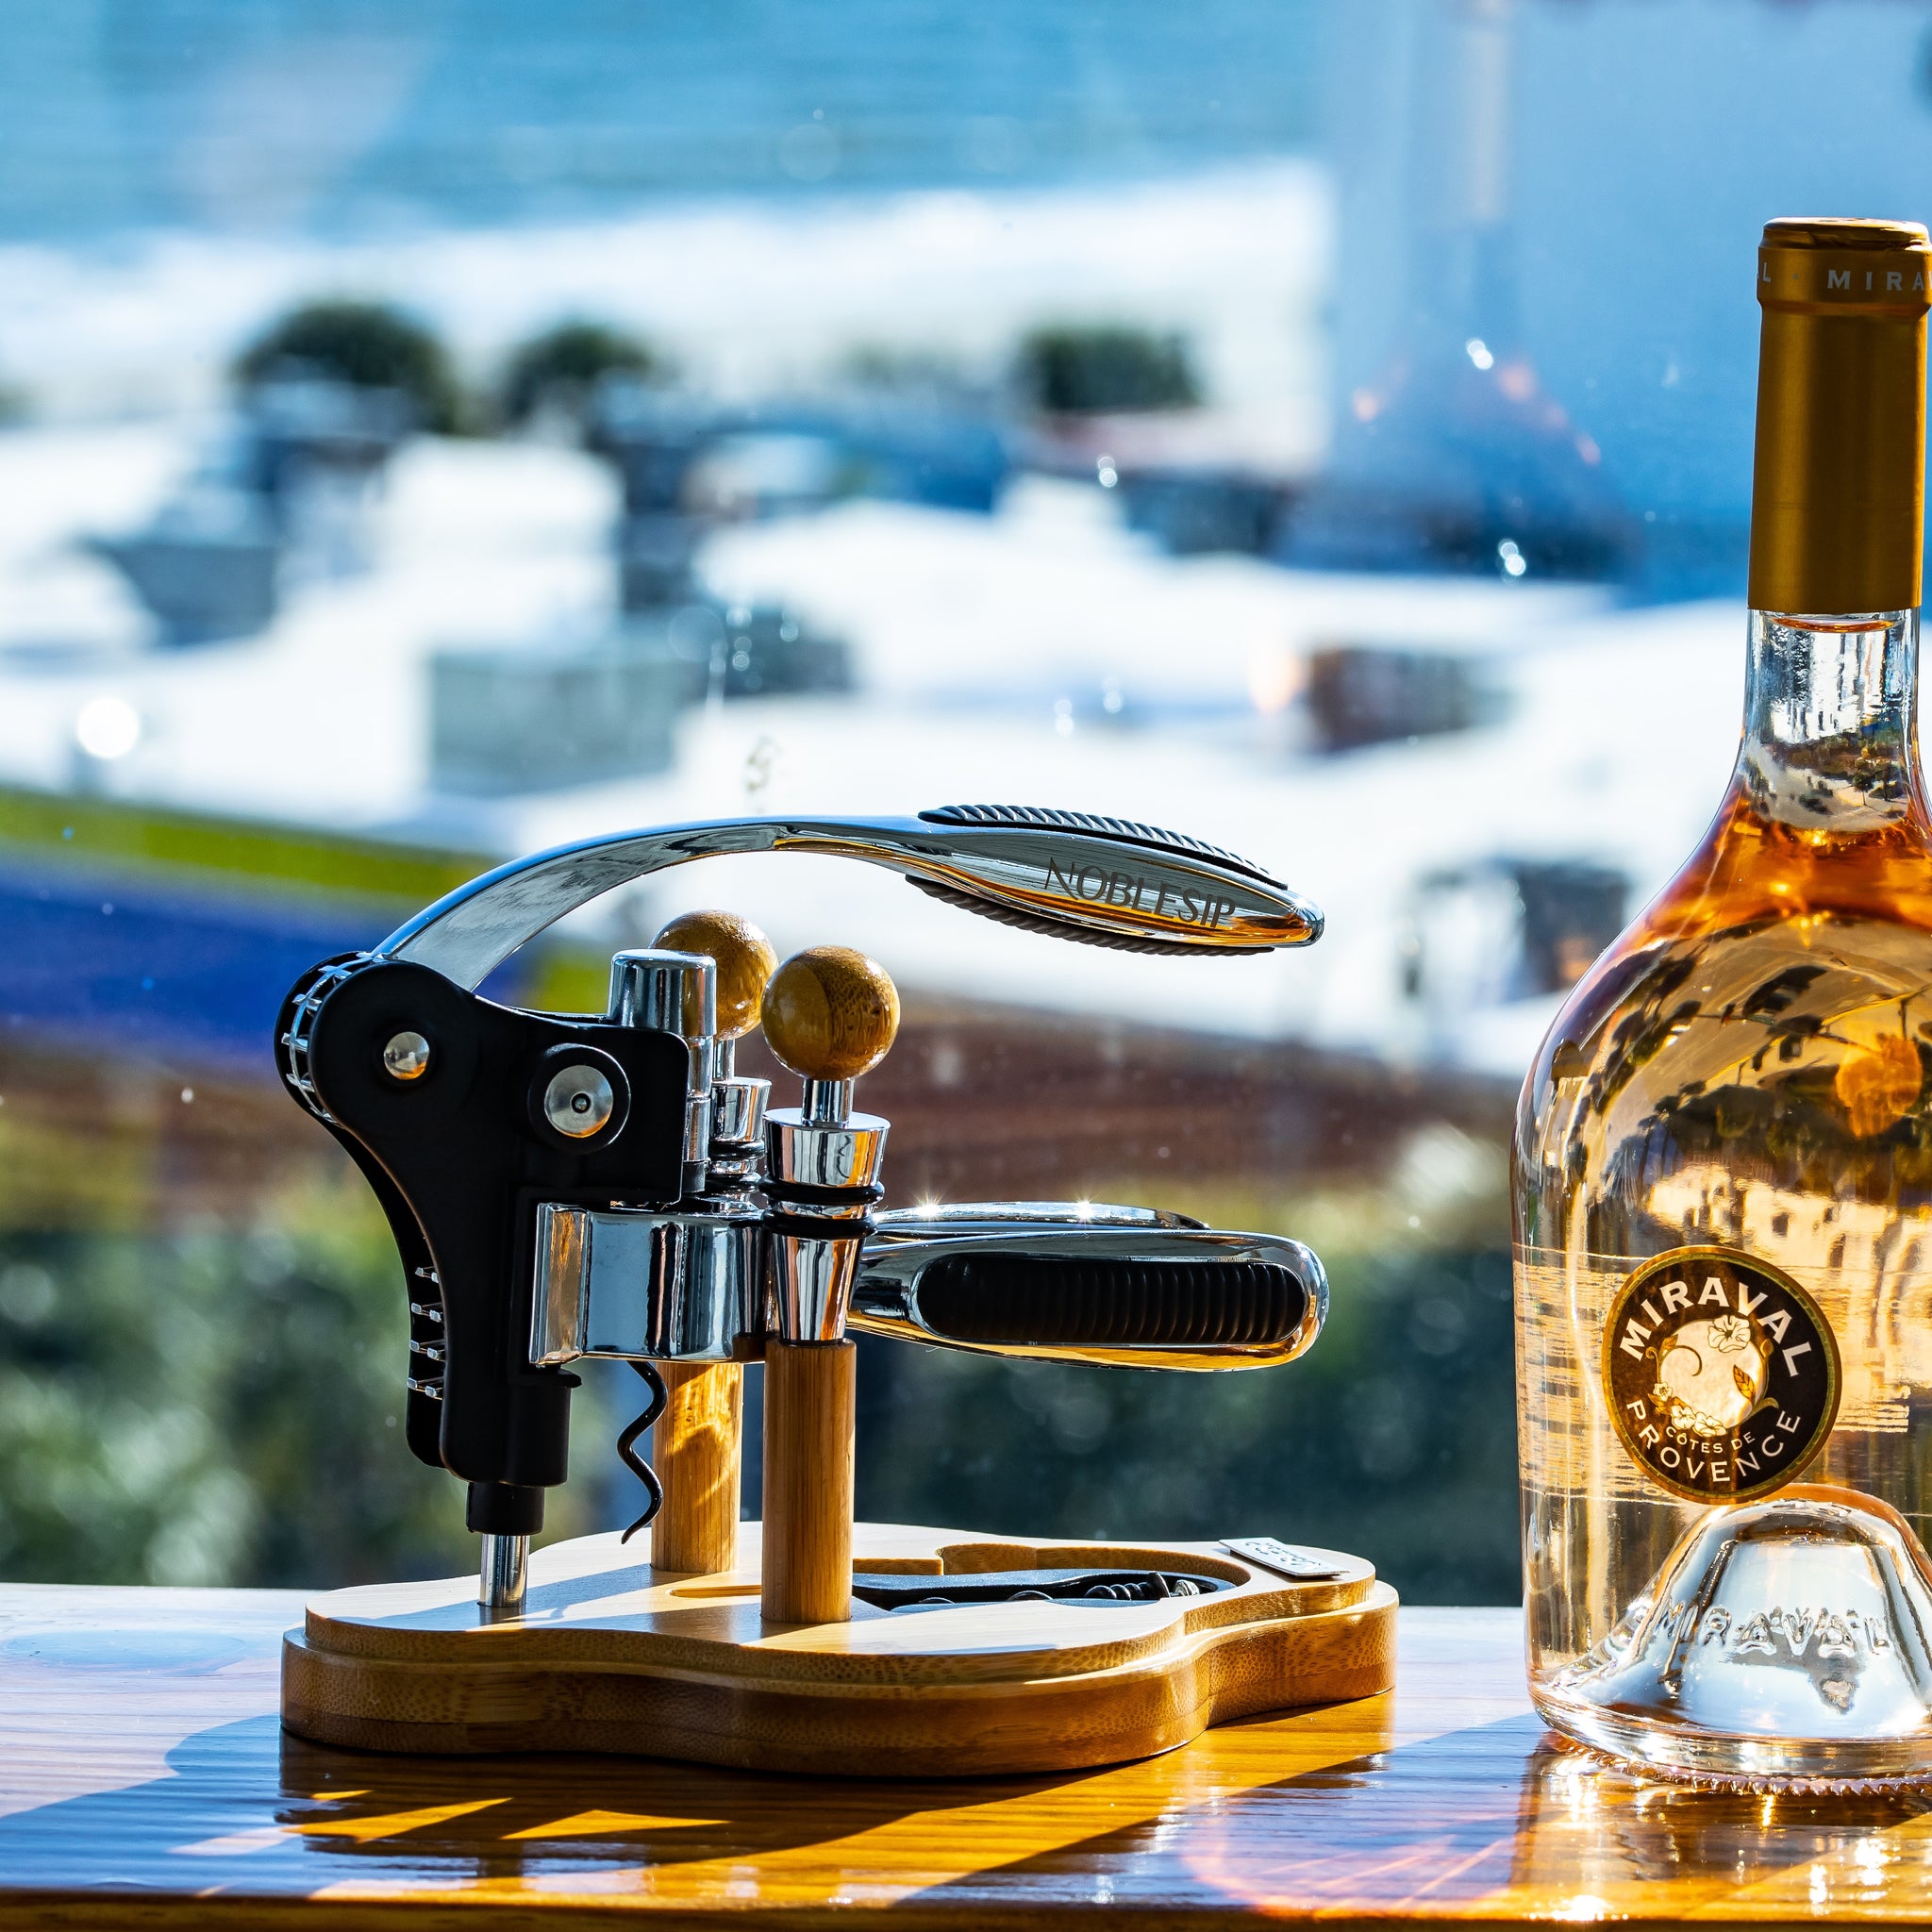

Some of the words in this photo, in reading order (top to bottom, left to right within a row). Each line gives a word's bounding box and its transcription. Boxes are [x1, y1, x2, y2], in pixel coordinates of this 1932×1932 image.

[1826, 269, 1932, 291] MIRA
[1043, 856, 1236, 929] NOBLESIP
[1619, 1276, 1812, 1377] MIRAVAL
[1625, 1399, 1801, 1483] PROVENCE
[1665, 1425, 1724, 1454] CÔTES
[1730, 1431, 1756, 1451] DE
[1657, 1602, 1890, 1657] MIRAVAL
